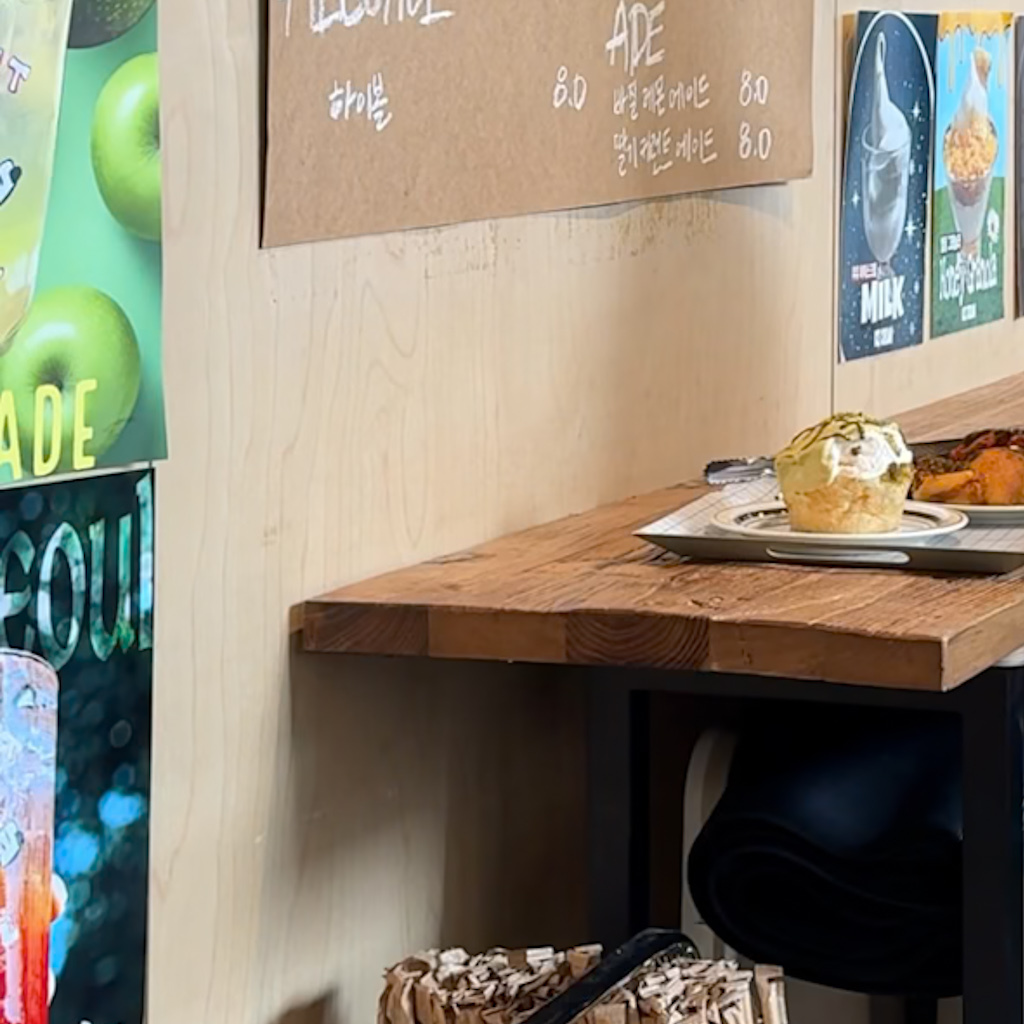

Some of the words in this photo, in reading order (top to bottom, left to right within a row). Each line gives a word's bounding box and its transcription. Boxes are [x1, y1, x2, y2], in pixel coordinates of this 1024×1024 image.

[605, 0, 665, 77] ADE
[328, 72, 392, 132] 하이볼
[553, 65, 587, 111] 8.0
[739, 69, 769, 106] 8.0
[739, 121, 772, 160] 8.0
[861, 275, 905, 324] MILK
